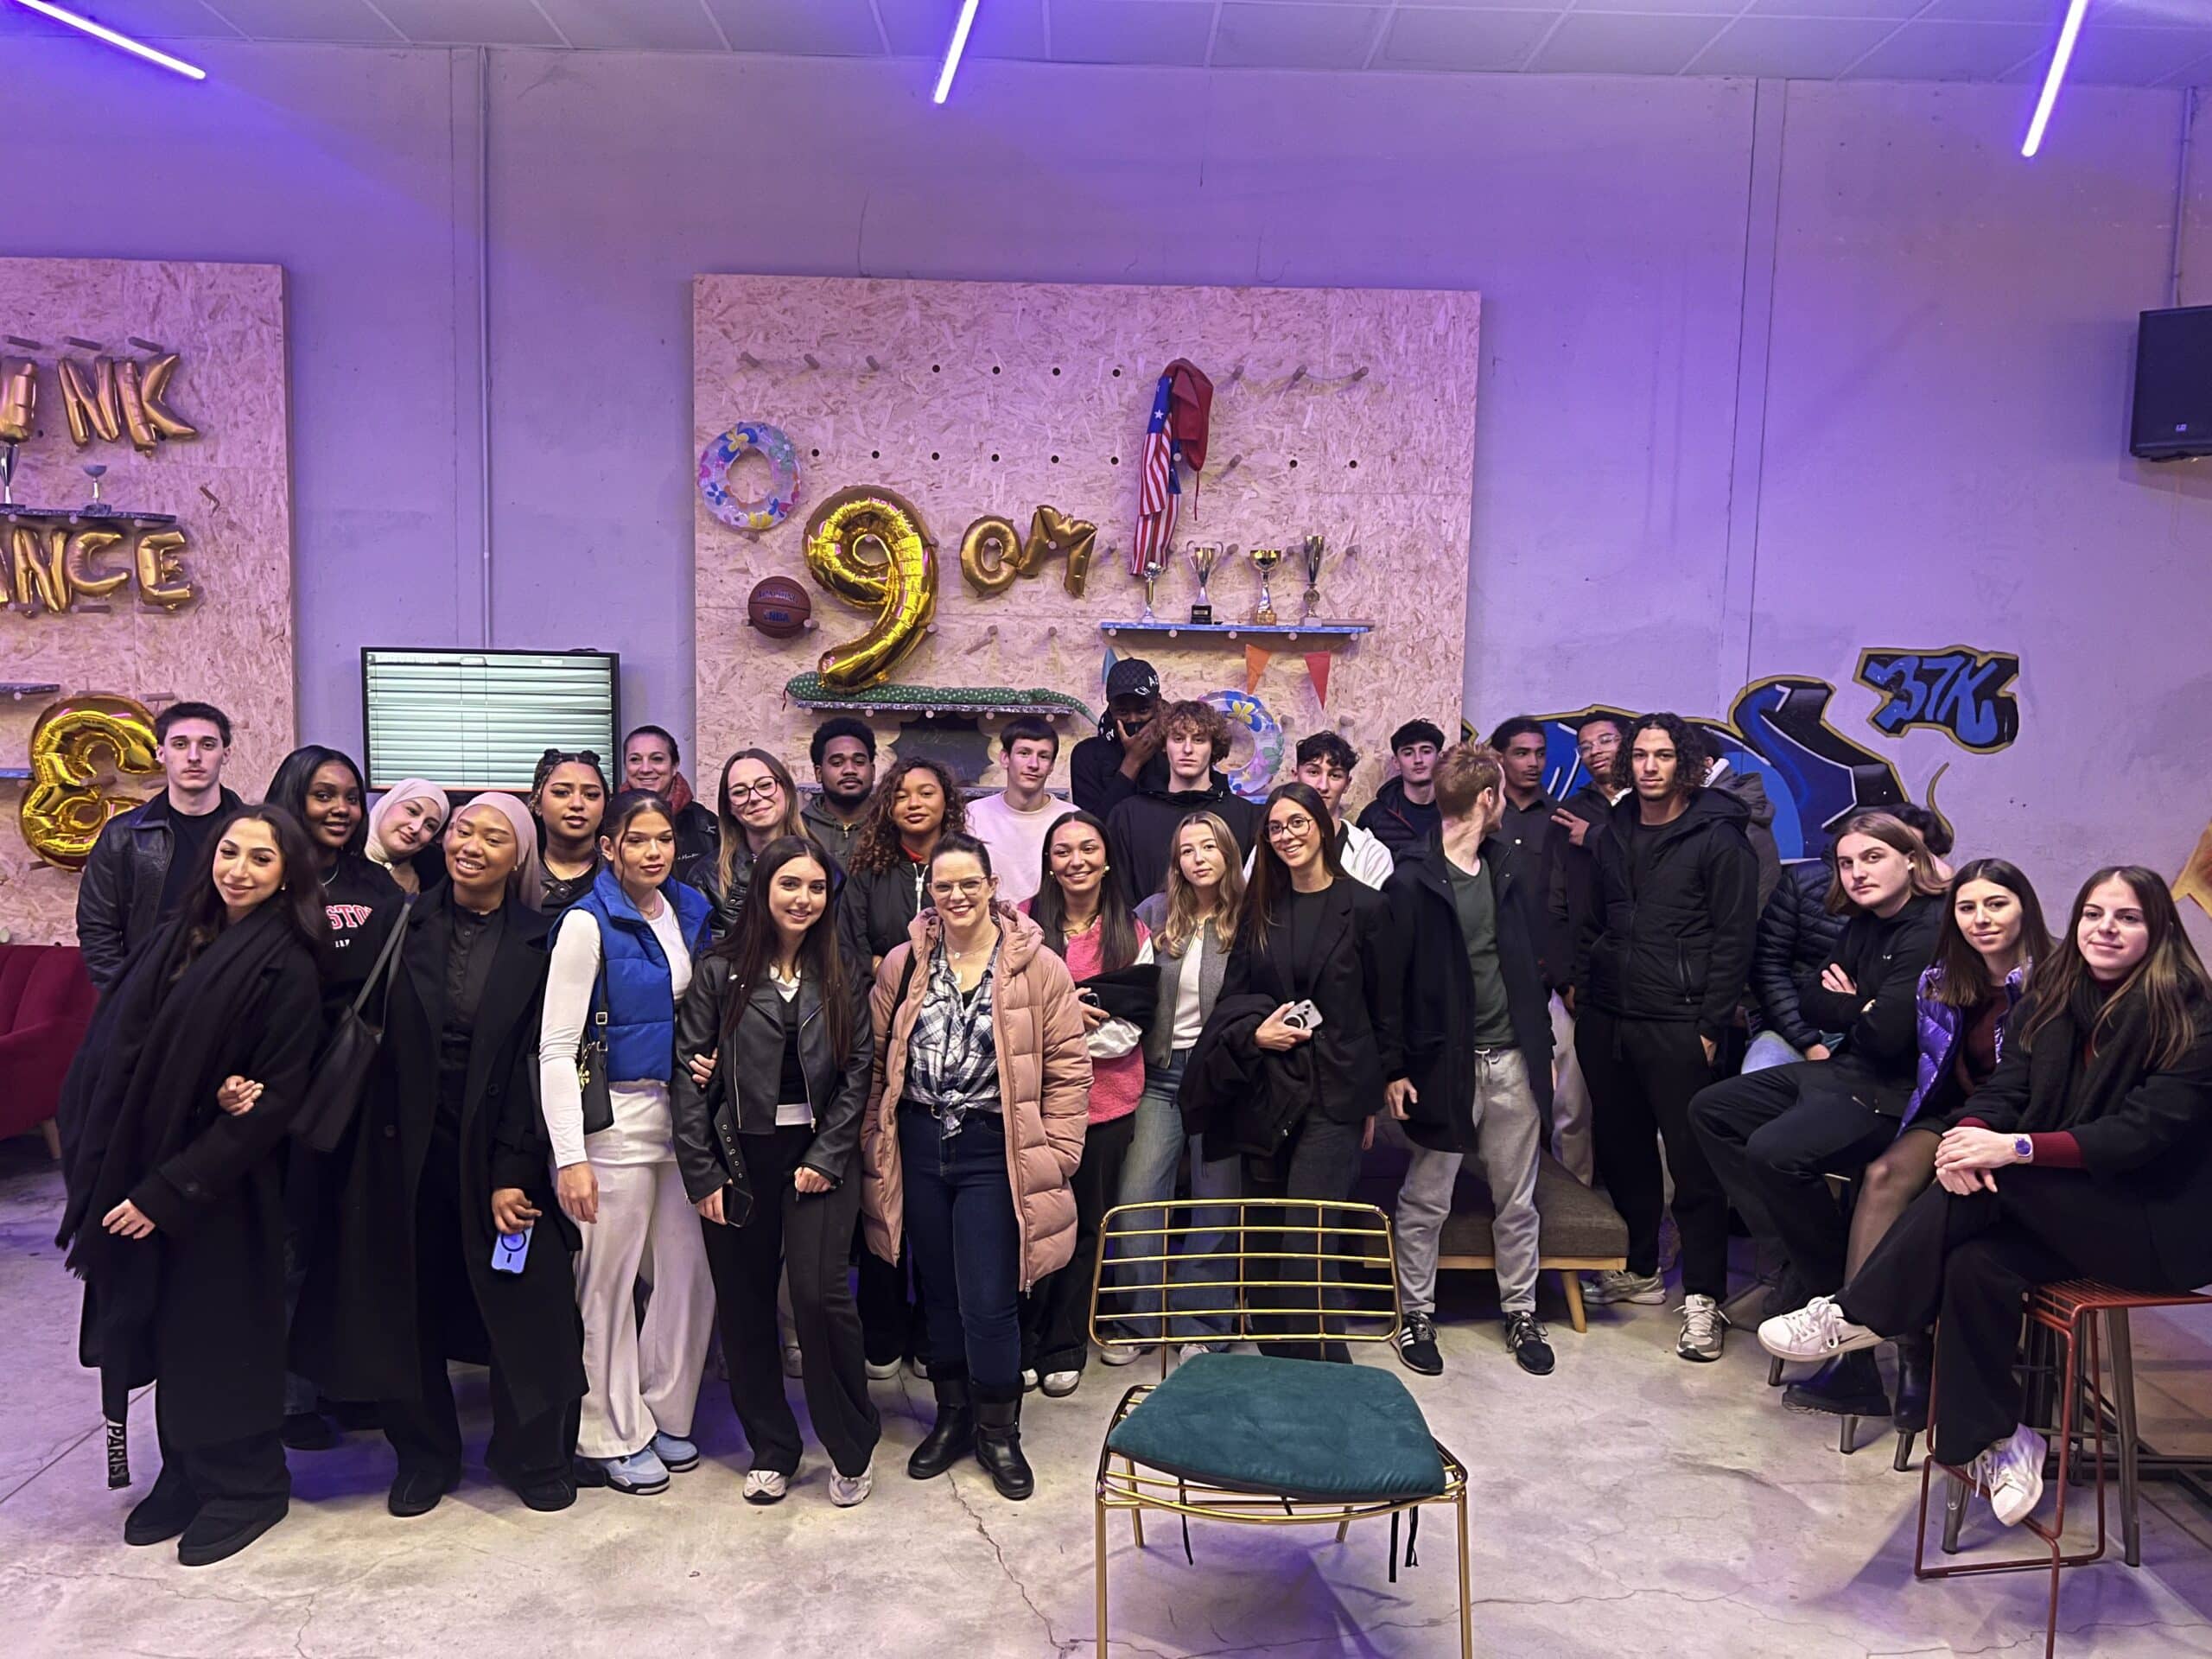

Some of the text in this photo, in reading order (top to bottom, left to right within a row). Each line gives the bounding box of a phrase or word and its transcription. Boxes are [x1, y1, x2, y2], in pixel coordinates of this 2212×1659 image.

[0, 524, 194, 615] NCE
[803, 484, 938, 693] 9
[106, 1426, 127, 1478] PARIS
